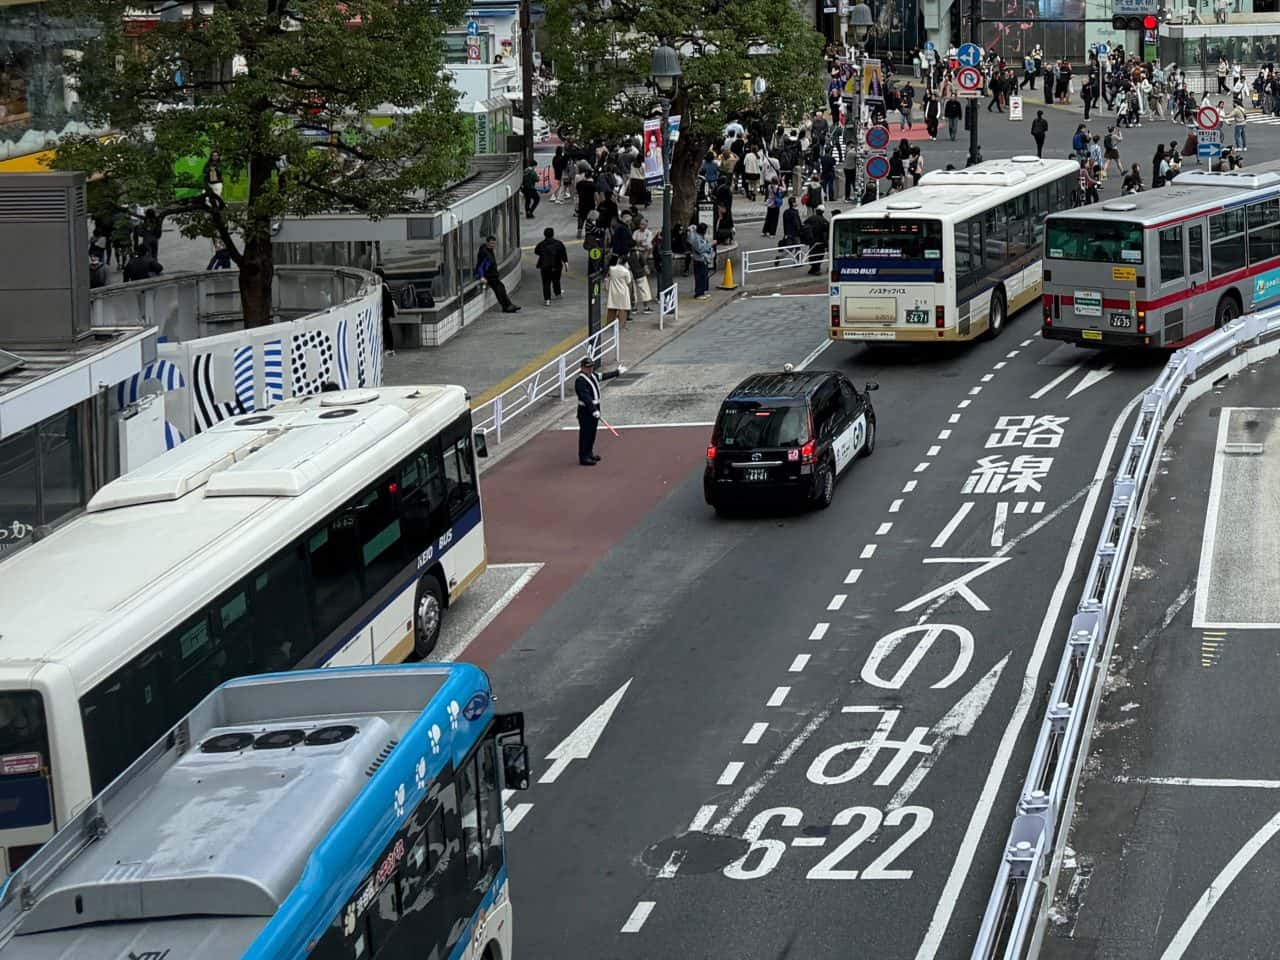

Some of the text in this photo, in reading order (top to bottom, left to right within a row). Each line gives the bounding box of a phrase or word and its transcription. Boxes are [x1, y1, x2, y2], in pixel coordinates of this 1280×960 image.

[860, 267, 878, 275] BUS
[438, 527, 453, 551] BUS
[806, 414, 1071, 787] 路線バスのみ
[723, 805, 935, 880] 6-22
